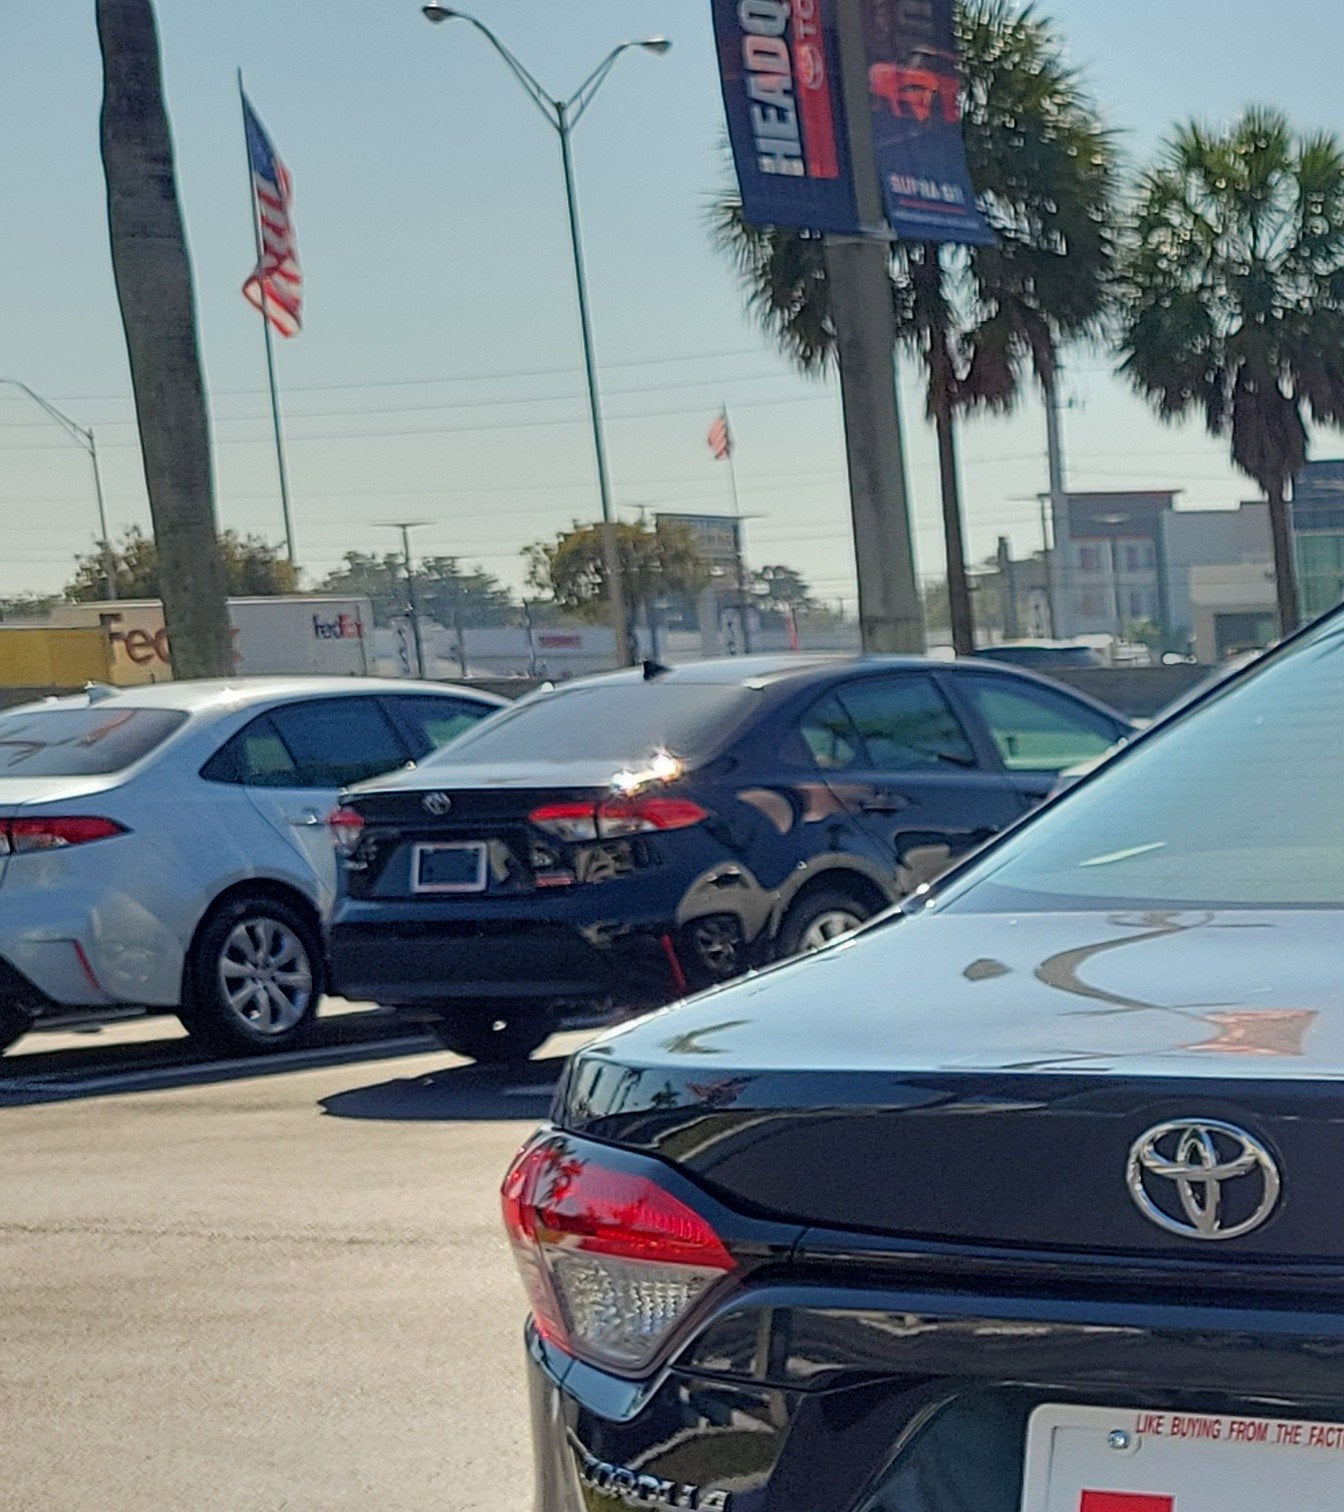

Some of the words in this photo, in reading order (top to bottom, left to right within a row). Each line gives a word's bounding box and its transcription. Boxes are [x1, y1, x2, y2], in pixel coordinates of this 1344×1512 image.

[1136, 1414, 1165, 1435] LIKE
[1170, 1416, 1222, 1440] BUYING
[1228, 1420, 1270, 1442] FROM
[1275, 1423, 1304, 1445] THE
